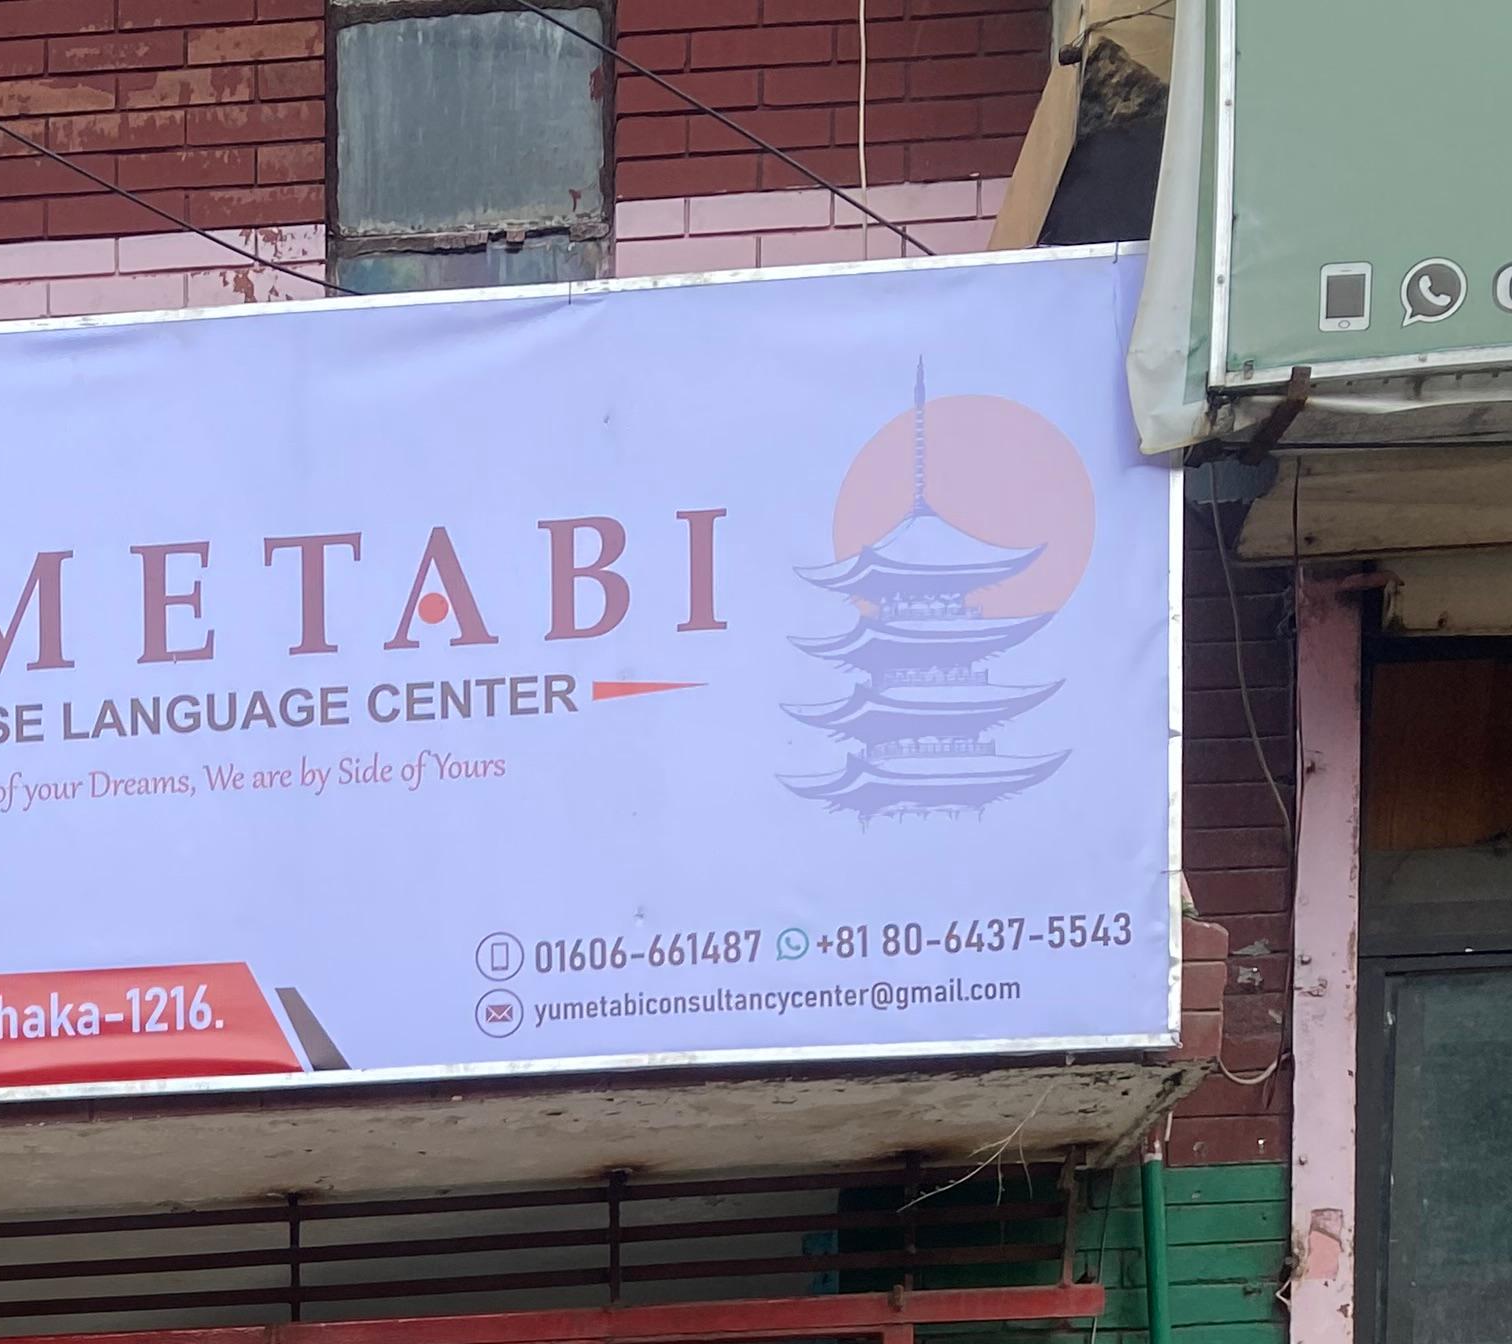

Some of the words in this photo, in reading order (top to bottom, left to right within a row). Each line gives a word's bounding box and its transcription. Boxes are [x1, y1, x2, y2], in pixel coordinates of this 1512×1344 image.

[63, 686, 349, 740] LANGUAGE
[367, 673, 579, 723] CENTER
[20, 780, 83, 812] your
[88, 766, 196, 799] Dreams,
[204, 762, 247, 791] We
[251, 767, 293, 789] are
[300, 755, 331, 795] by
[337, 755, 393, 786] Side
[401, 749, 433, 791] of
[431, 751, 506, 780] Yours
[534, 929, 761, 975] 01606-661487
[817, 924, 869, 959] +81
[881, 912, 1133, 959] 80-6437-5543
[534, 979, 1021, 1027] yumetabiconsultancycenter@gmail.com
